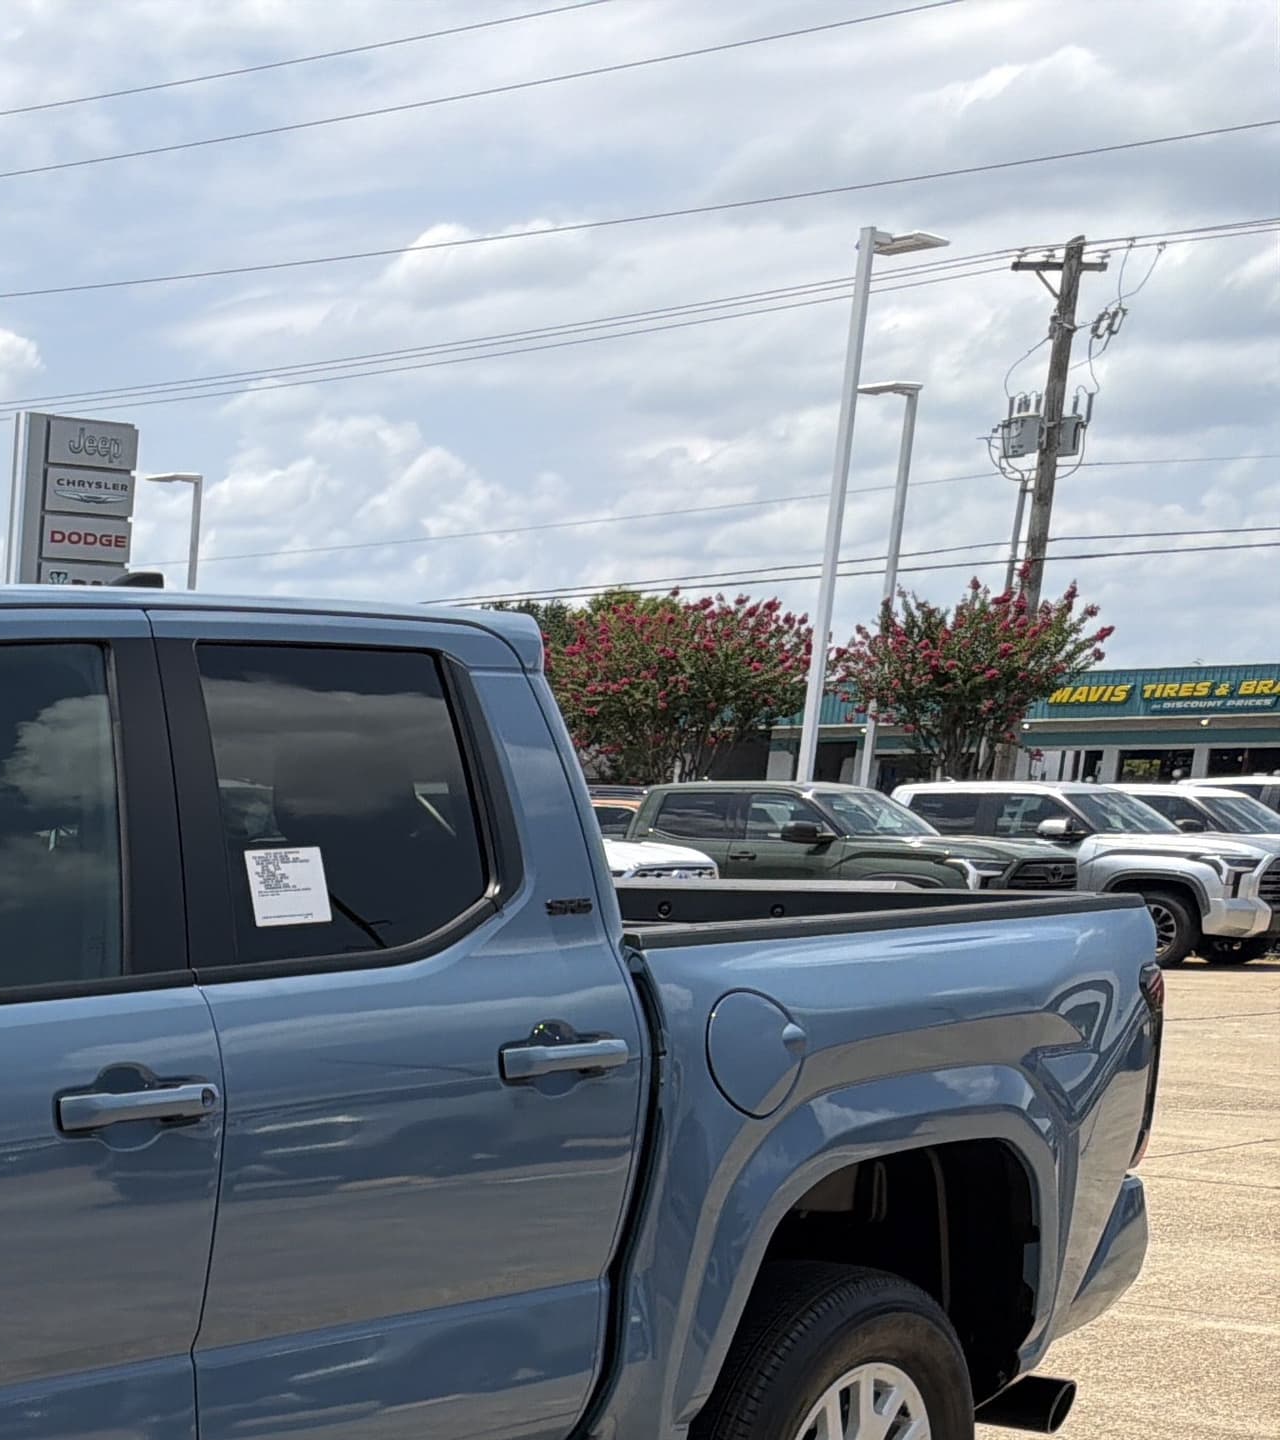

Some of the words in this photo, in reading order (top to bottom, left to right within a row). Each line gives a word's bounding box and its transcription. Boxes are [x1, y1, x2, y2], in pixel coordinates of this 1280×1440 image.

[68, 427, 124, 463] Jeep
[56, 478, 129, 492] CHRYSLER
[50, 530, 127, 549] DODGE
[1047, 683, 1131, 704] MAVIS
[1143, 682, 1213, 699] TIRES
[1214, 683, 1232, 696] &
[1162, 701, 1221, 709] DISCOUNT
[1226, 698, 1272, 707] PRICES
